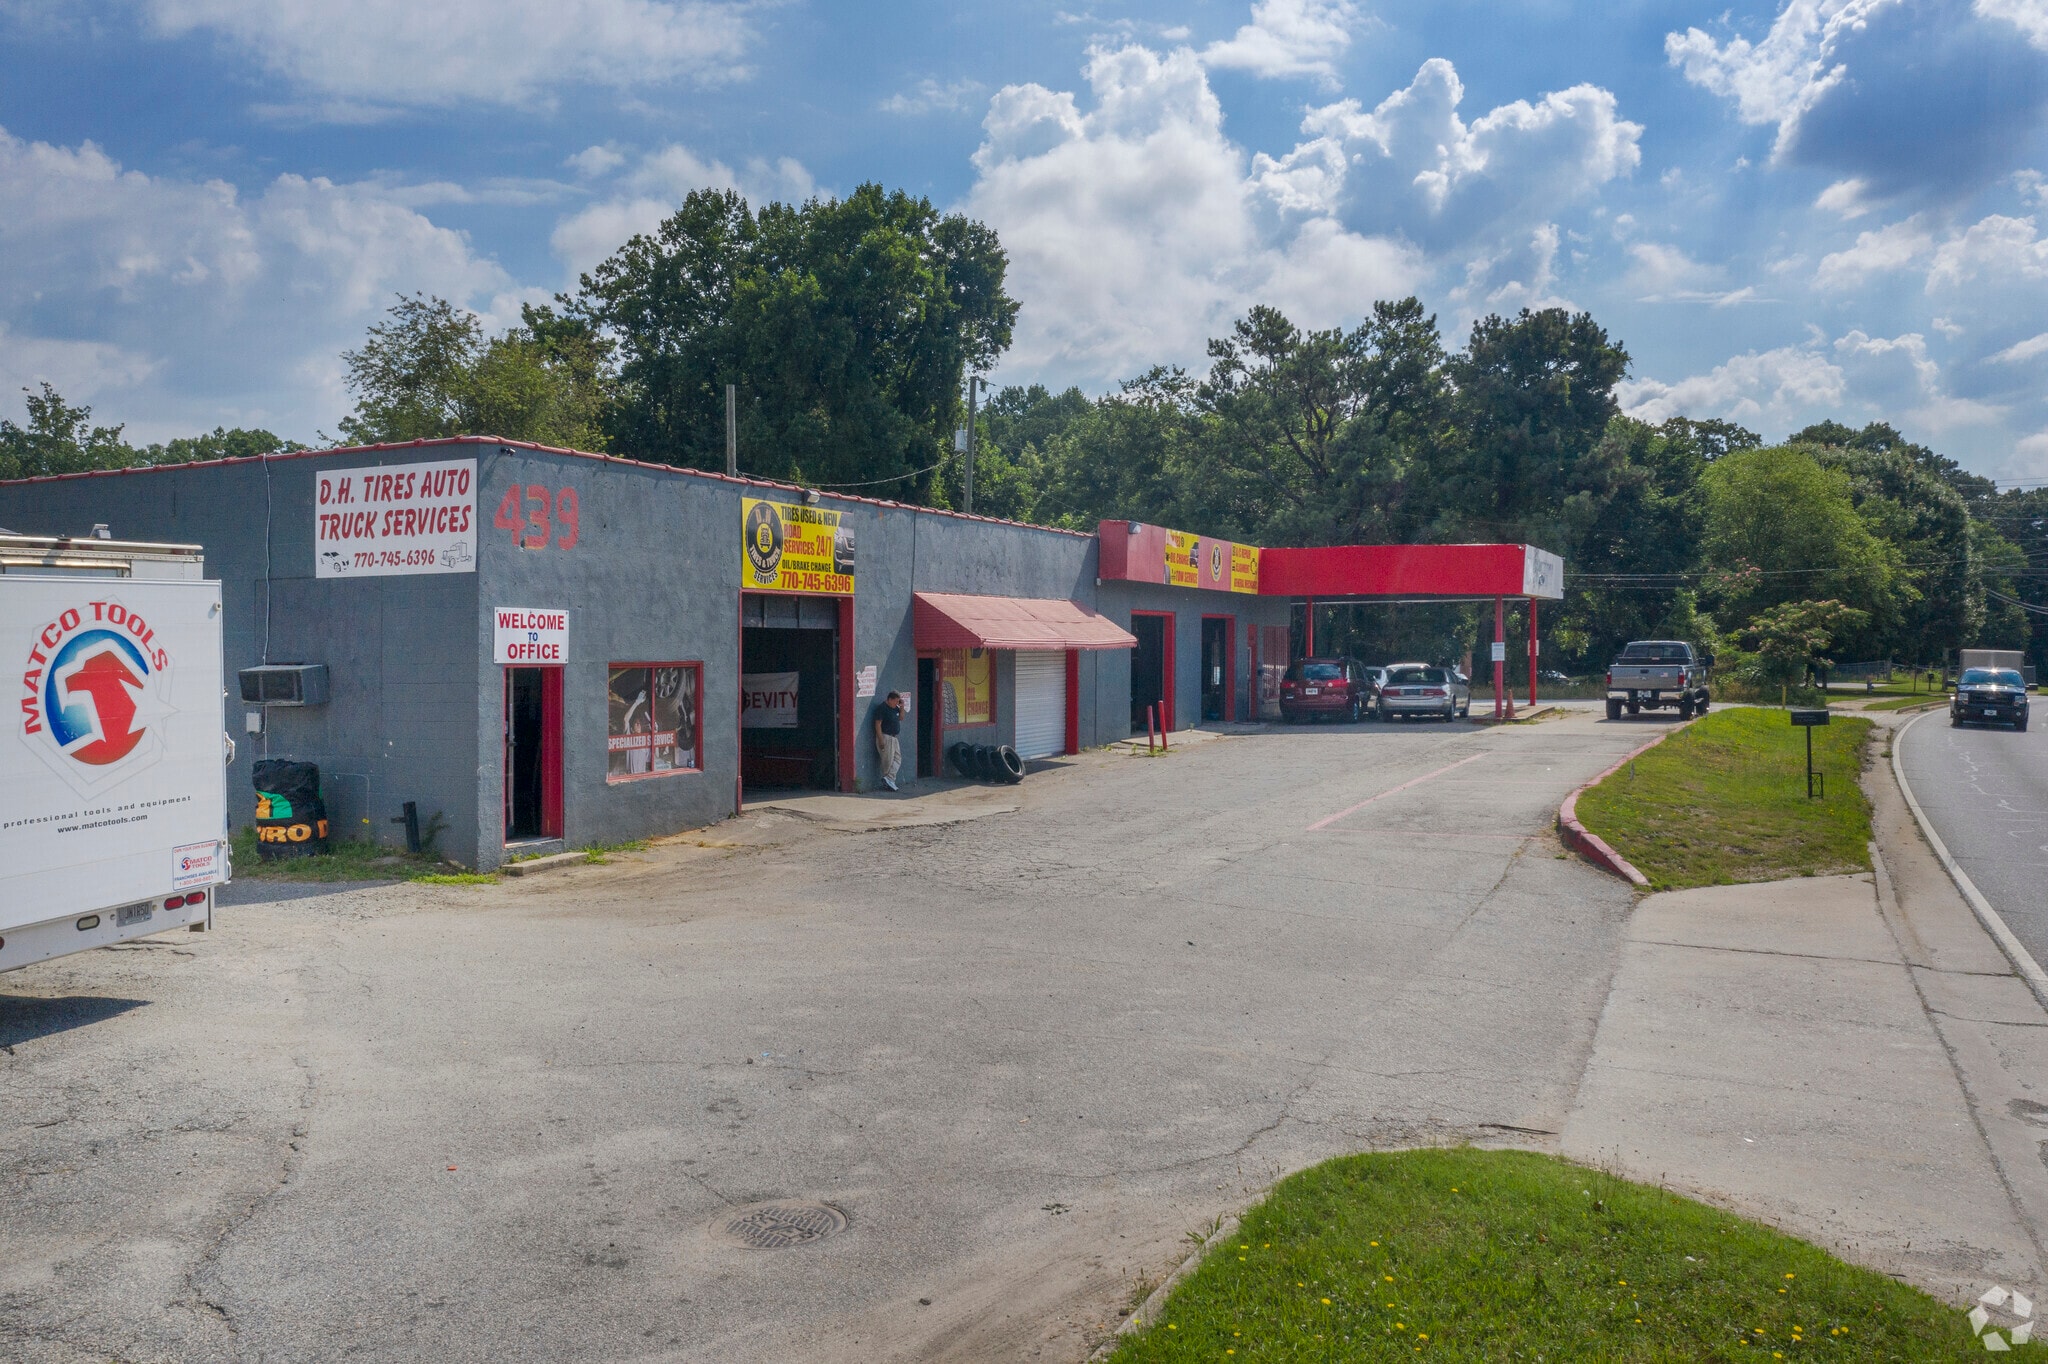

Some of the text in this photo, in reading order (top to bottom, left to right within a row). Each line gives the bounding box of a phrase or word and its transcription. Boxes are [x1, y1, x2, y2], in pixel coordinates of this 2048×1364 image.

[319, 468, 470, 505] D.H. TIRES AUTO
[320, 505, 471, 541] TRUCK SERVICES
[494, 484, 579, 551] 439
[781, 506, 838, 527] TIRES USED & NEW
[784, 524, 802, 539] ROAD
[784, 535, 832, 557] SERVICES 24/7
[354, 549, 435, 568] 770-745-6396
[782, 559, 832, 573] OIL/BRAKE CHANGE
[753, 569, 778, 585] SERVICES
[781, 571, 851, 592] 770-745-6396
[498, 613, 565, 630] WELCOME
[528, 632, 538, 641] TO
[507, 643, 560, 659] OFFICE
[21, 602, 168, 735] MATCO TOOLS
[608, 735, 646, 749] SPECIALIZED
[3, 795, 192, 829] professional tools and equipment
[57, 814, 148, 834] www.matcotools.com
[190, 856, 212, 864] MATCO
